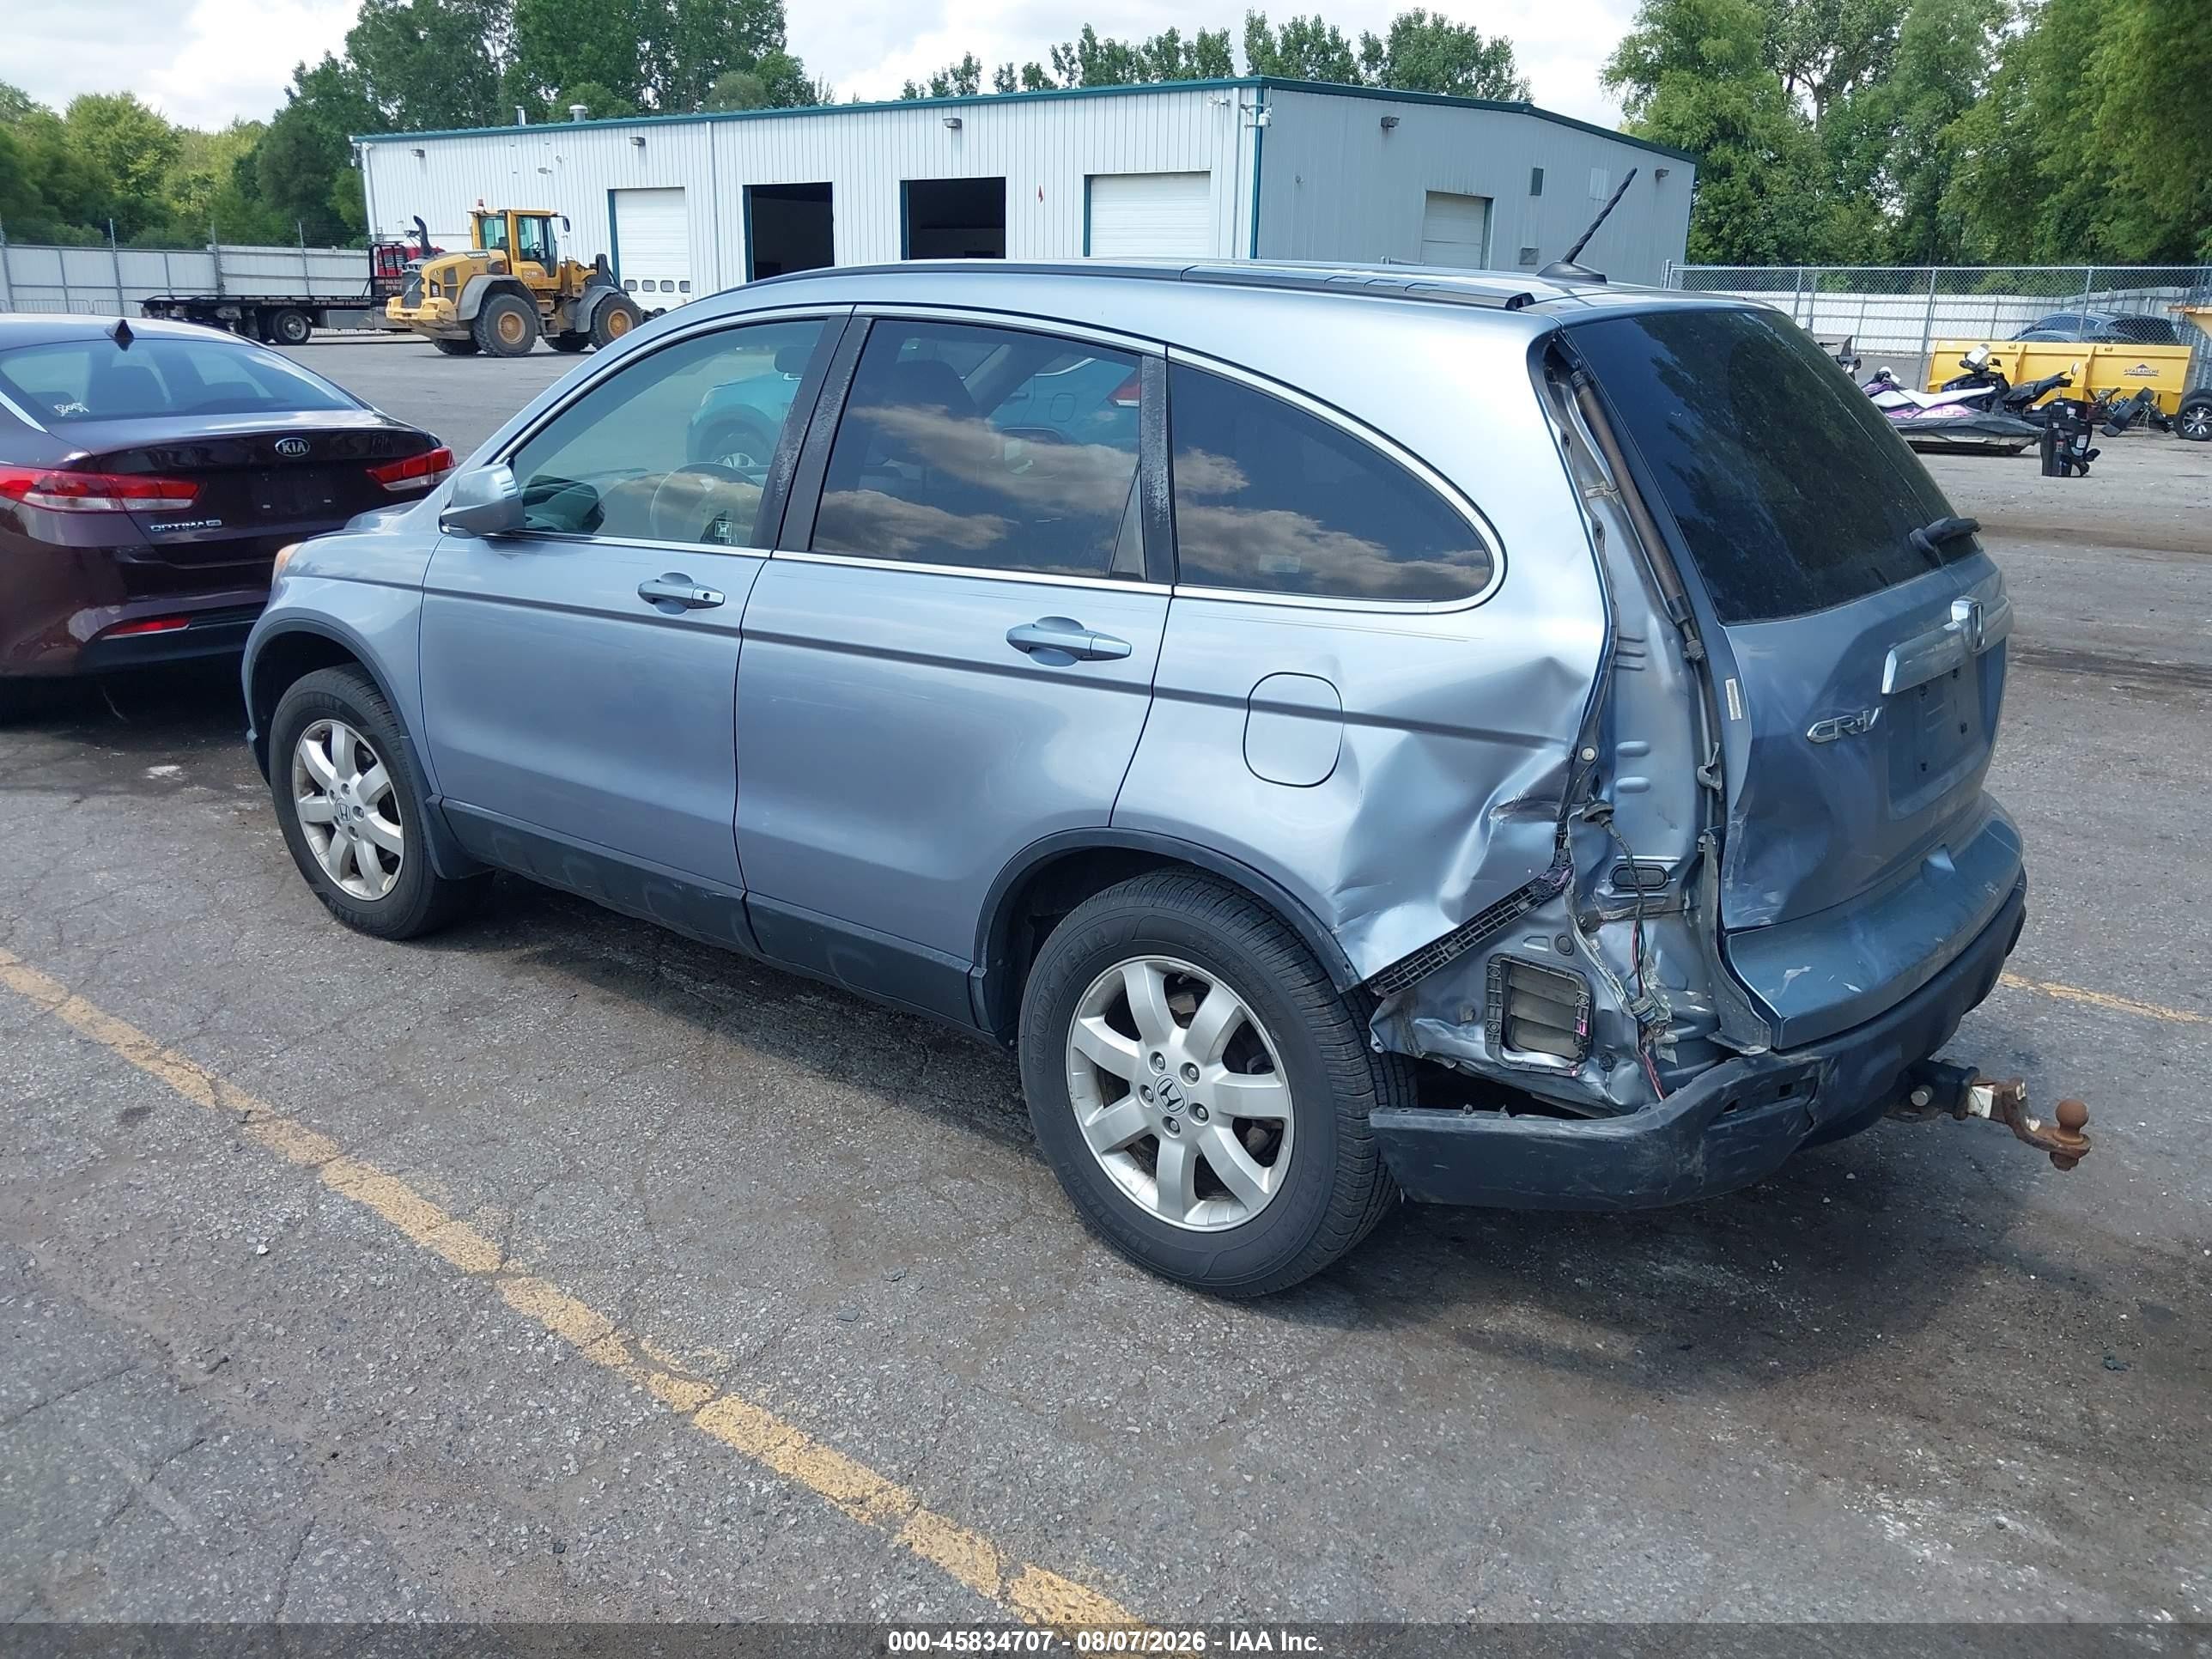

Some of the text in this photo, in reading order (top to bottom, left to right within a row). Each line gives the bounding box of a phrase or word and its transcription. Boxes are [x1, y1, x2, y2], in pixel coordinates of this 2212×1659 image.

[282, 441, 306, 453] KIA
[150, 520, 205, 532] OPTIMA
[1807, 707, 1883, 744] CR-V
